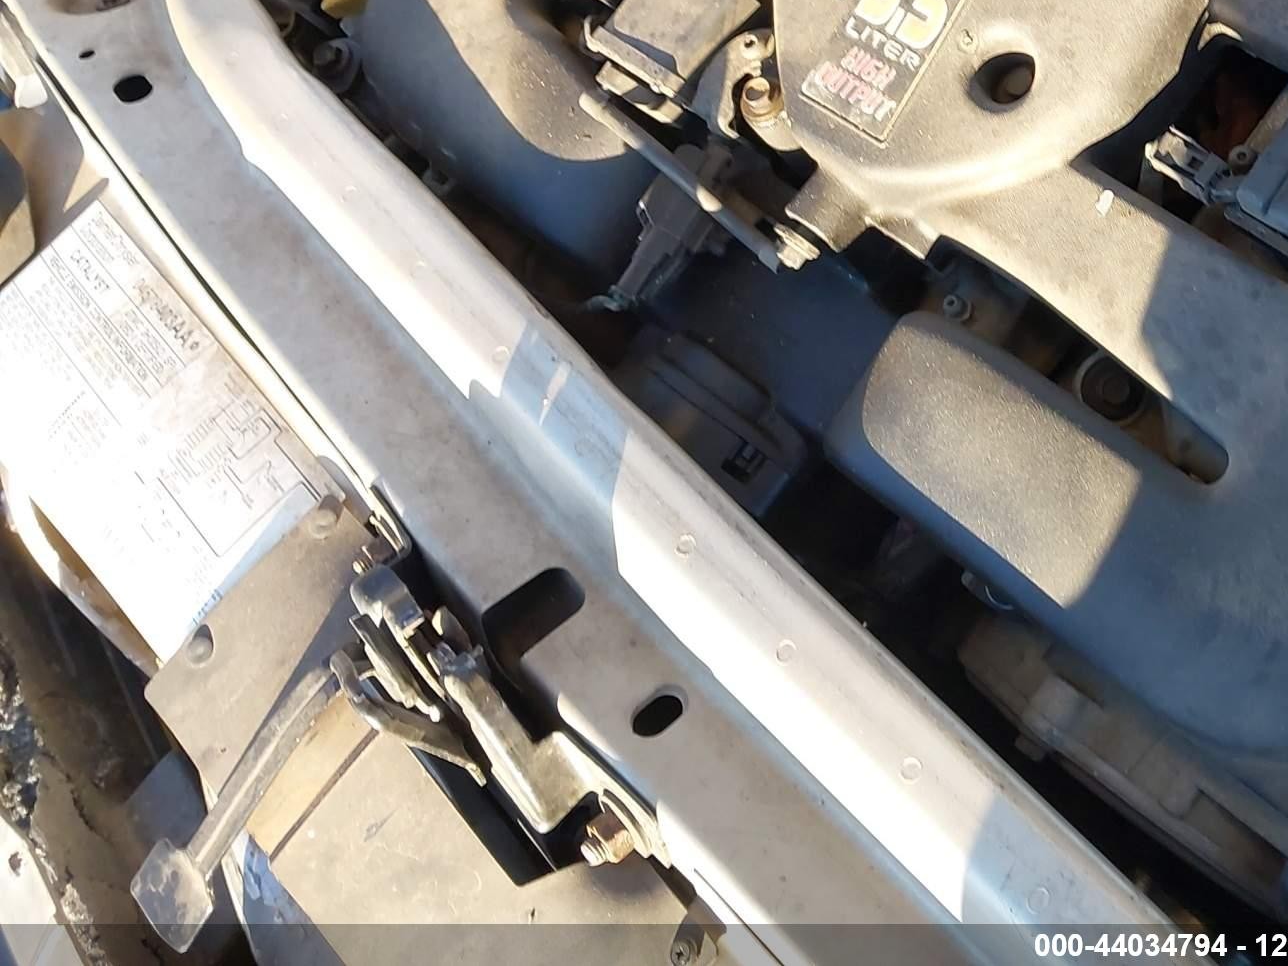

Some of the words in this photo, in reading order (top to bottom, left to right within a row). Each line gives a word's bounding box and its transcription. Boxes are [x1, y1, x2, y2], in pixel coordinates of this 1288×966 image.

[841, 46, 897, 89] HIGH
[845, 17, 923, 72] LITER
[814, 60, 898, 122] OUTPUT
